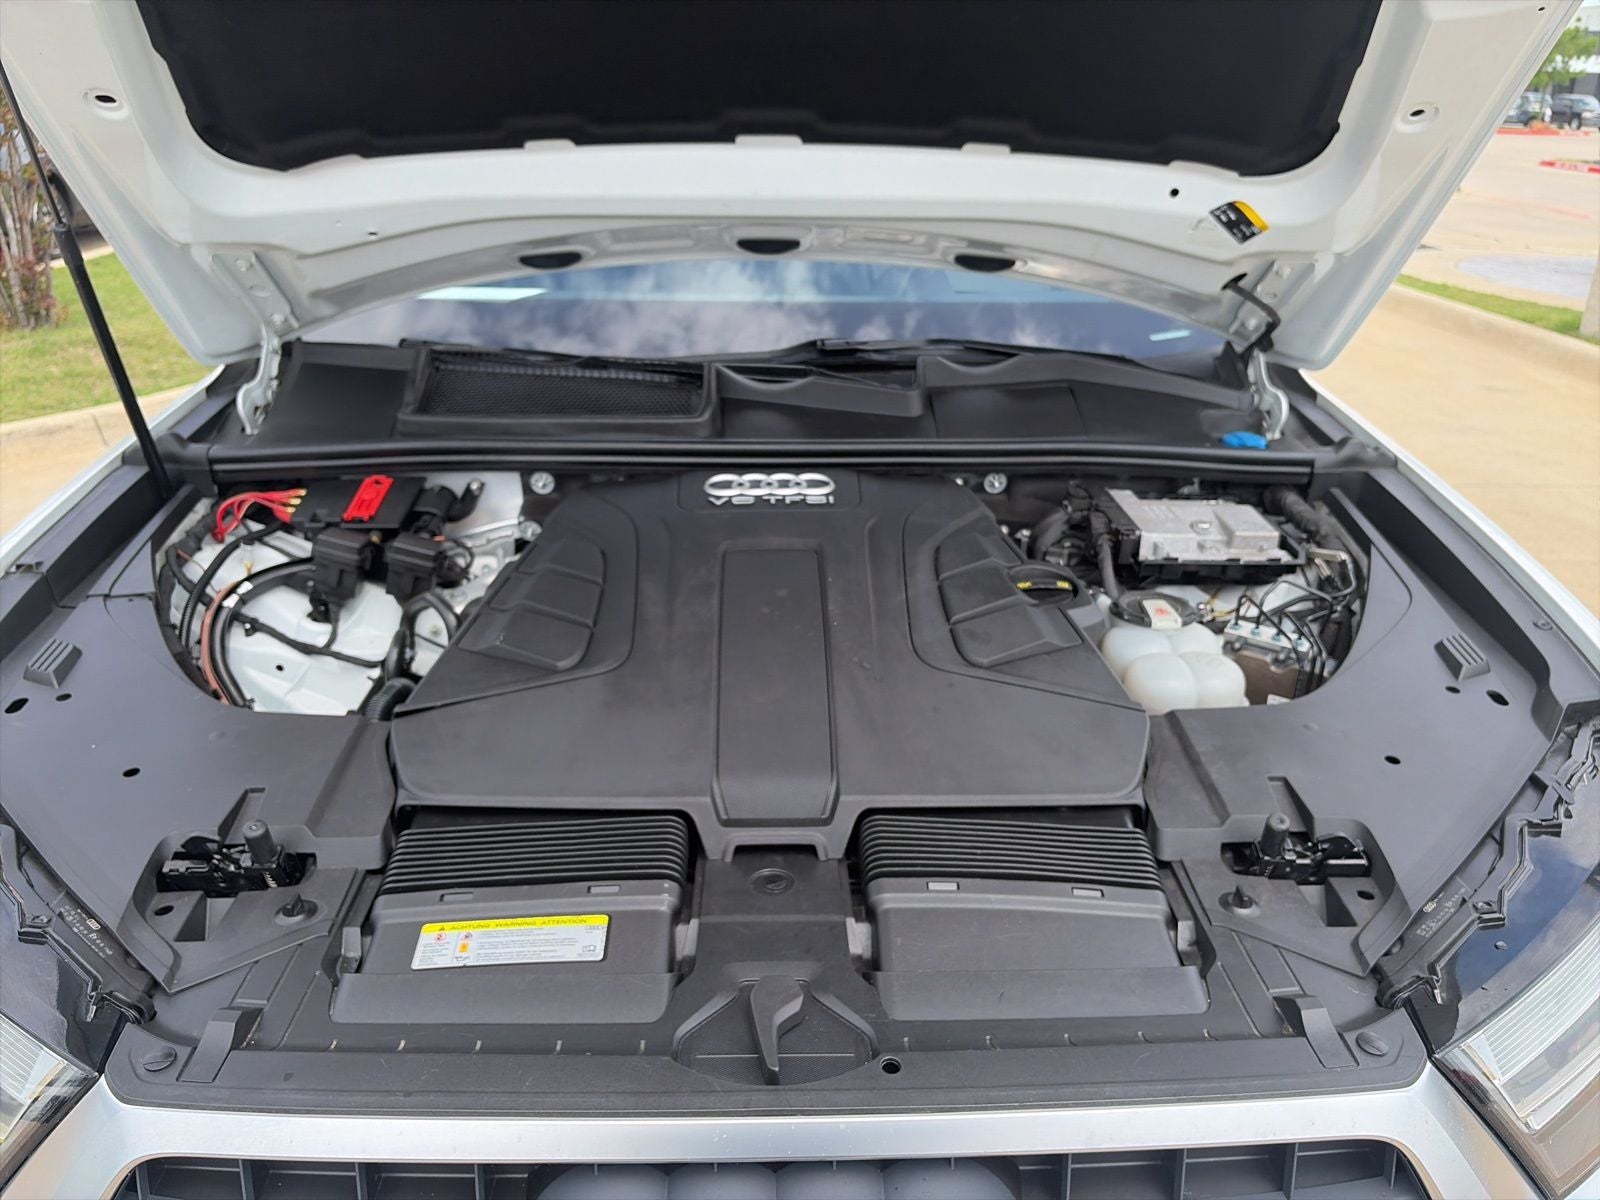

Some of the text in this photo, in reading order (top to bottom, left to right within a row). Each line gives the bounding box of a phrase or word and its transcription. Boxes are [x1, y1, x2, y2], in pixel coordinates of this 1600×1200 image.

[708, 495, 834, 506] V6 TFSI
[450, 918, 588, 931] ACHTUNG WARNING ATTENTION
